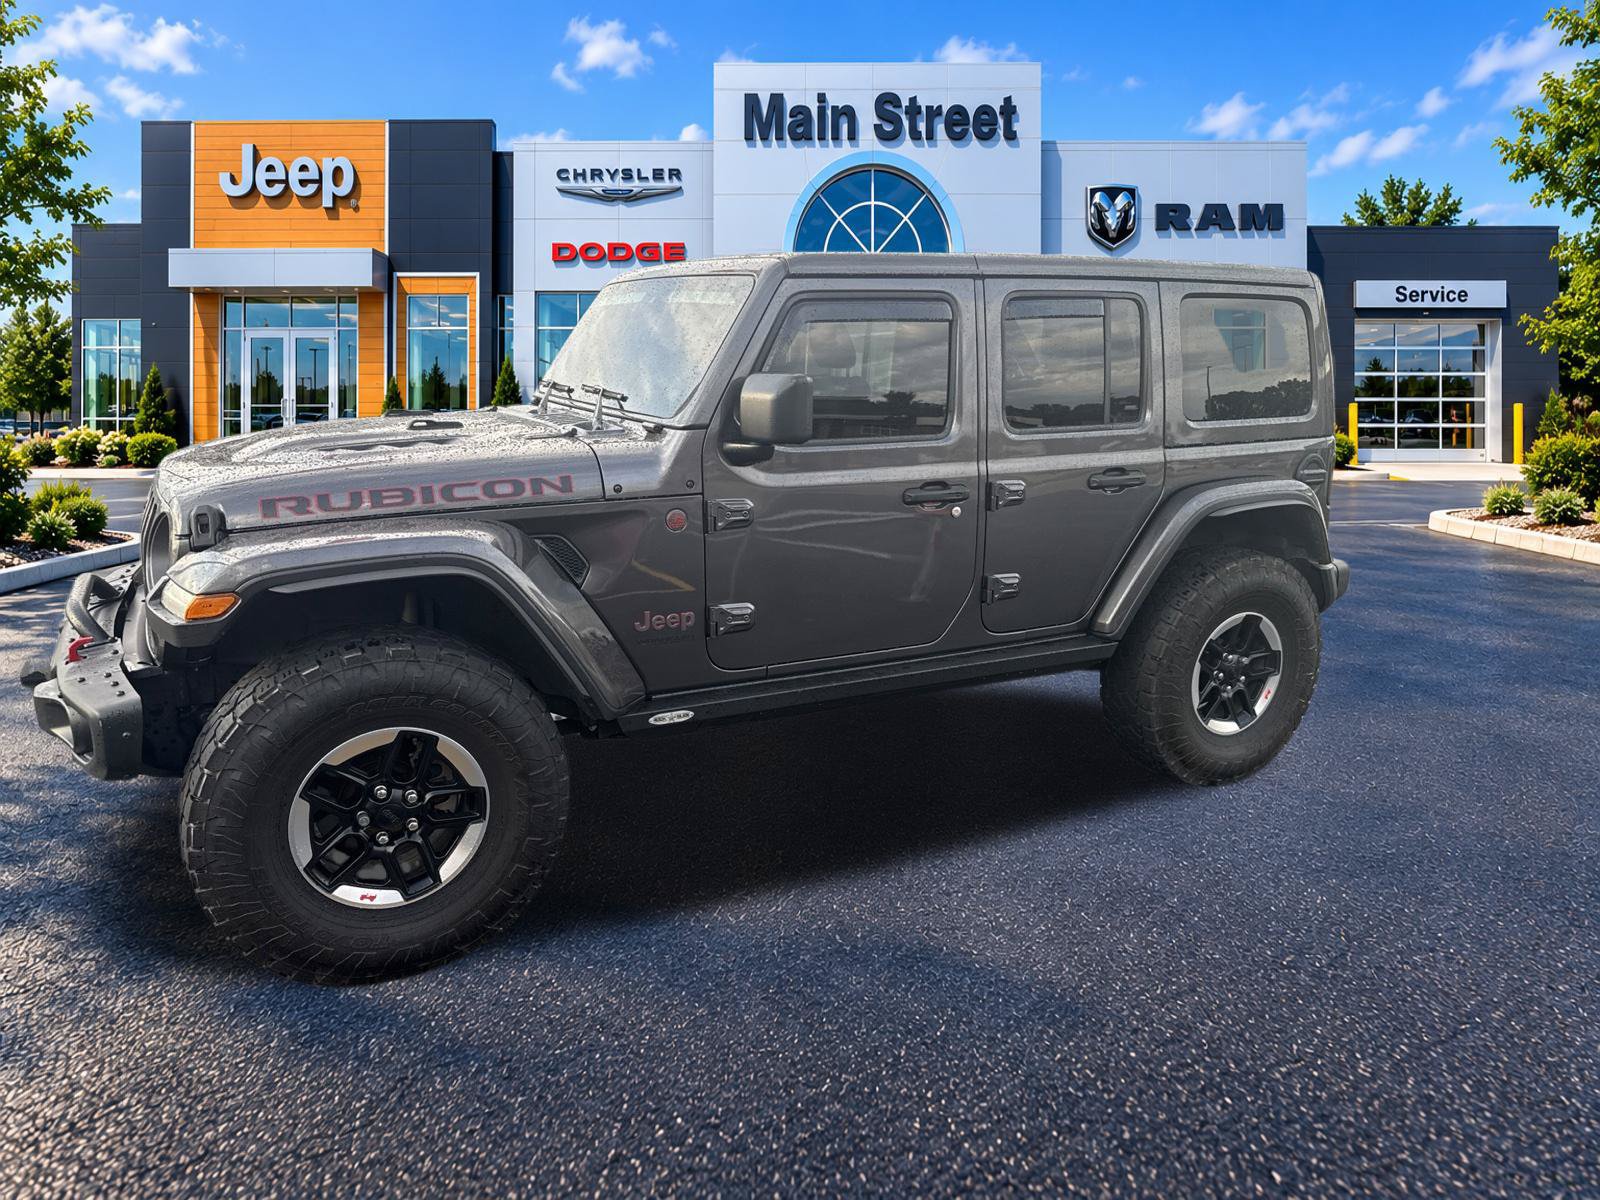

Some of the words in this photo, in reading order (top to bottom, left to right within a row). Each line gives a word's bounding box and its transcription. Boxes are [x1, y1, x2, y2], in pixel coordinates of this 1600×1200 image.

[744, 92, 858, 142] Main
[873, 91, 1018, 142] Street
[218, 143, 355, 208] Jeep
[556, 168, 683, 183] CHRYSLER
[1155, 203, 1284, 232] RAM
[551, 241, 687, 262] DODGE
[1395, 285, 1469, 303] Service
[258, 474, 574, 519] RUBICON
[633, 610, 696, 632] Jeep
